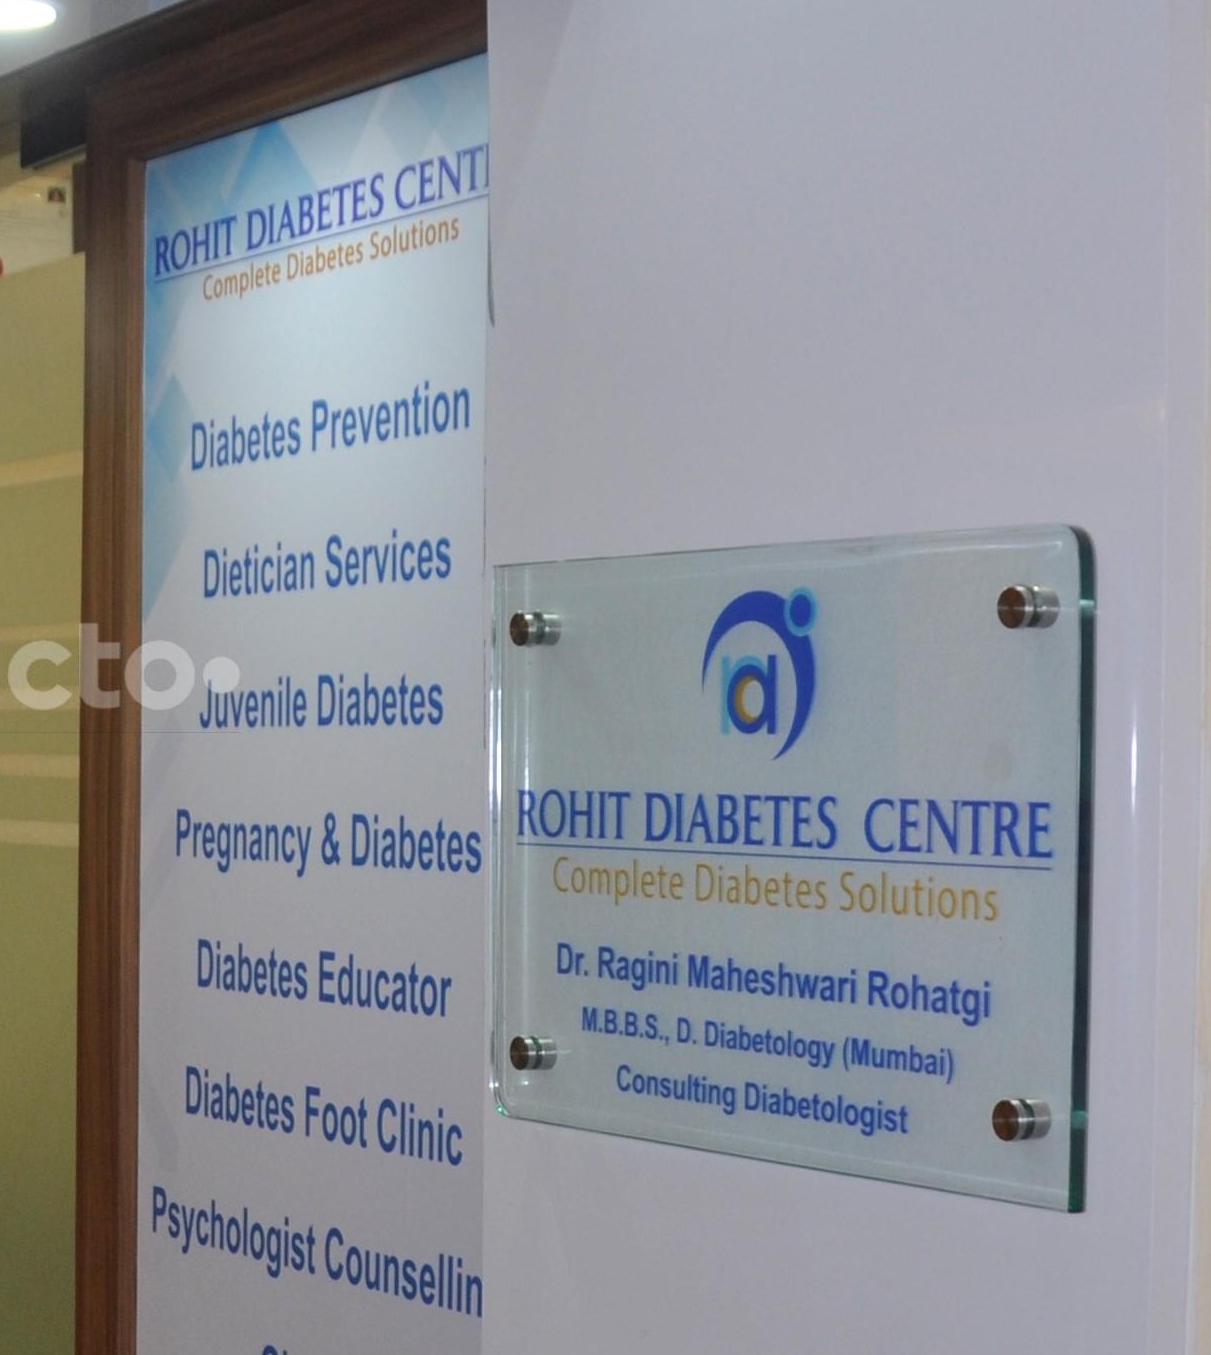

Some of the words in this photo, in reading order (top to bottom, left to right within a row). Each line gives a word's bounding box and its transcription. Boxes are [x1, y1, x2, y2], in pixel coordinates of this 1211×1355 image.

[154, 215, 237, 276] ROHIT
[245, 172, 385, 251] DIABETES
[394, 143, 488, 209] CENT
[203, 260, 281, 301] Complete
[287, 239, 363, 281] Diabetes
[370, 215, 459, 260] Solutions
[191, 411, 301, 471] Diabetes
[311, 380, 470, 452] Prevention
[203, 543, 315, 599] Dietician
[325, 529, 452, 588] Services
[199, 676, 307, 731] Juvenile
[317, 673, 443, 727] Diabetes
[176, 808, 311, 878] Pregnancy
[321, 812, 341, 866] &
[351, 813, 482, 873] Diabetes
[517, 788, 631, 842] ROHIT
[644, 791, 839, 851] DIABETES
[863, 797, 1054, 860] CENTRE
[552, 856, 684, 906] Complete
[694, 863, 827, 912] Diabetes
[839, 871, 999, 923] Solutions
[197, 938, 307, 1001] Diabetes
[319, 951, 452, 1017] Educator
[557, 941, 589, 978] Dr.
[598, 945, 679, 992] Ragini
[688, 953, 857, 1005] Maheshwari
[868, 970, 992, 1026] Rohatgi
[581, 1005, 670, 1044] M.B.B.S.,
[676, 1016, 697, 1047] D.
[704, 1020, 836, 1070] Diabetology
[842, 1036, 954, 1085] (Mumbai)
[186, 1065, 295, 1134] Diabetes
[305, 1086, 367, 1148] Foot
[377, 1098, 463, 1166] Clinic
[616, 1064, 736, 1116] Consulting
[744, 1081, 908, 1137] Diabetologist
[152, 1185, 315, 1278] Psychologist
